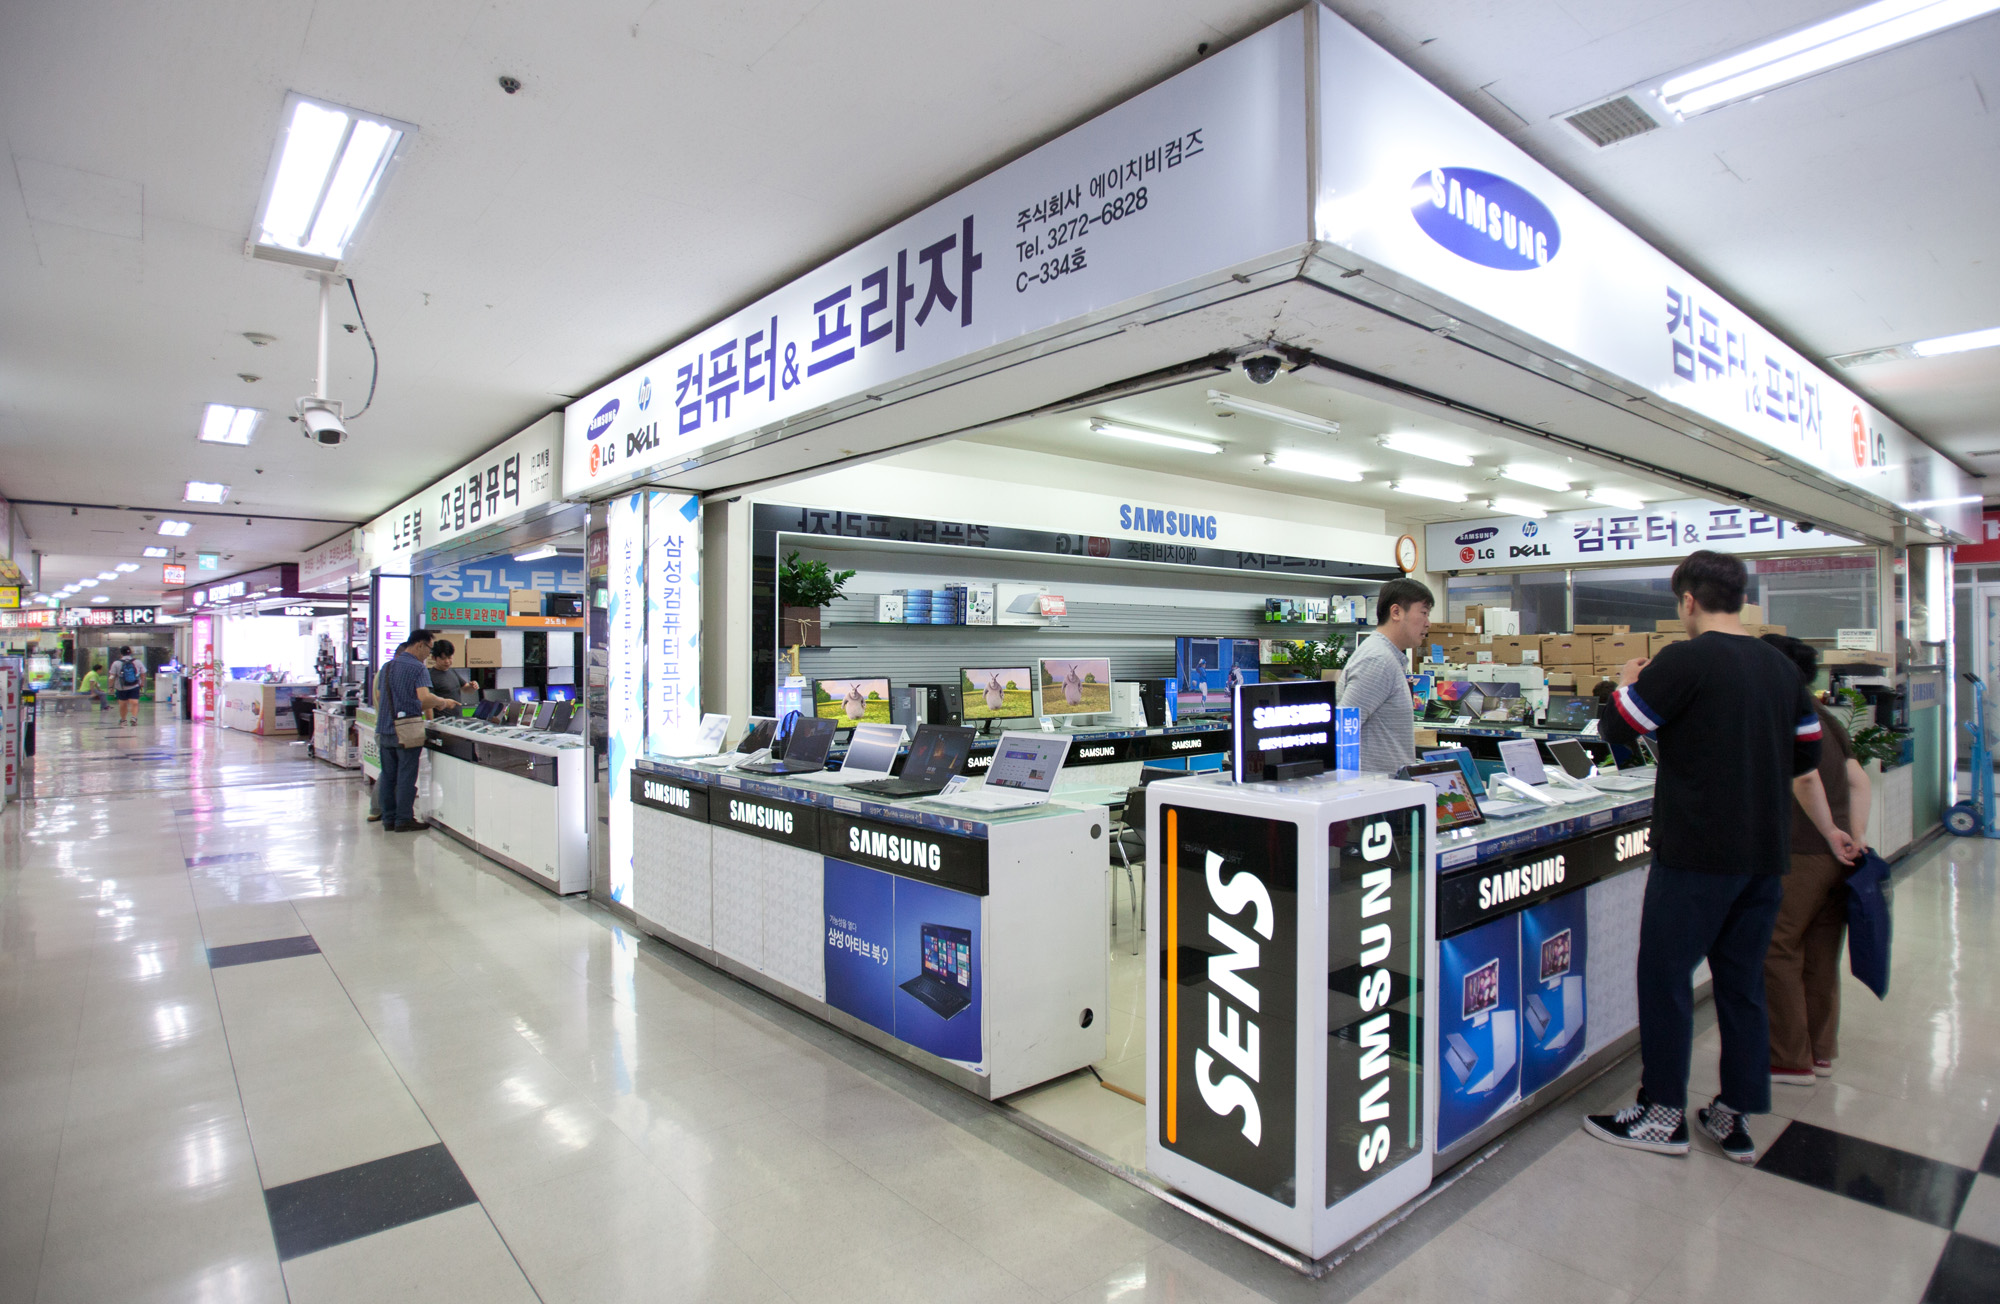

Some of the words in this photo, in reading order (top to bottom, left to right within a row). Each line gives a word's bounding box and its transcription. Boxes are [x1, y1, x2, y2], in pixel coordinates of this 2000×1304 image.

[1016, 184, 1081, 232] 주식회사
[1089, 128, 1204, 199] 에이치비컴즈
[1016, 235, 1044, 262] Tel.
[1047, 186, 1148, 250] 3272-6828
[1430, 167, 1549, 267] SAMSUNG
[1016, 246, 1088, 293] C-334호
[590, 409, 618, 431] SAMSUNG
[602, 443, 615, 467] LG
[626, 422, 660, 458] DELL
[393, 507, 422, 551] 노트북
[439, 452, 520, 532] 조립컴퓨터
[1120, 504, 1217, 541] SAMSUNG
[1459, 531, 1495, 541] SAMSUNG
[1573, 508, 1828, 553] 컴퓨터&프라
[1478, 547, 1495, 560] LG
[1509, 543, 1551, 558] DELL
[430, 607, 471, 622] 중고노트북
[662, 535, 684, 729] 삼성컴퓨터프라자
[1080, 747, 1115, 758] SAMSUNG
[1172, 739, 1202, 750] SAMSUNG
[644, 780, 690, 809] SAMSUNG
[730, 800, 793, 834] SAMSUNG
[849, 826, 941, 871] SAMSUNG
[1479, 855, 1566, 910] SAMSUNG
[828, 928, 844, 949] 삼성
[845, 934, 871, 957] 아티브
[1195, 849, 1274, 1148] SENS
[1358, 821, 1393, 1173] SAMSUNG
